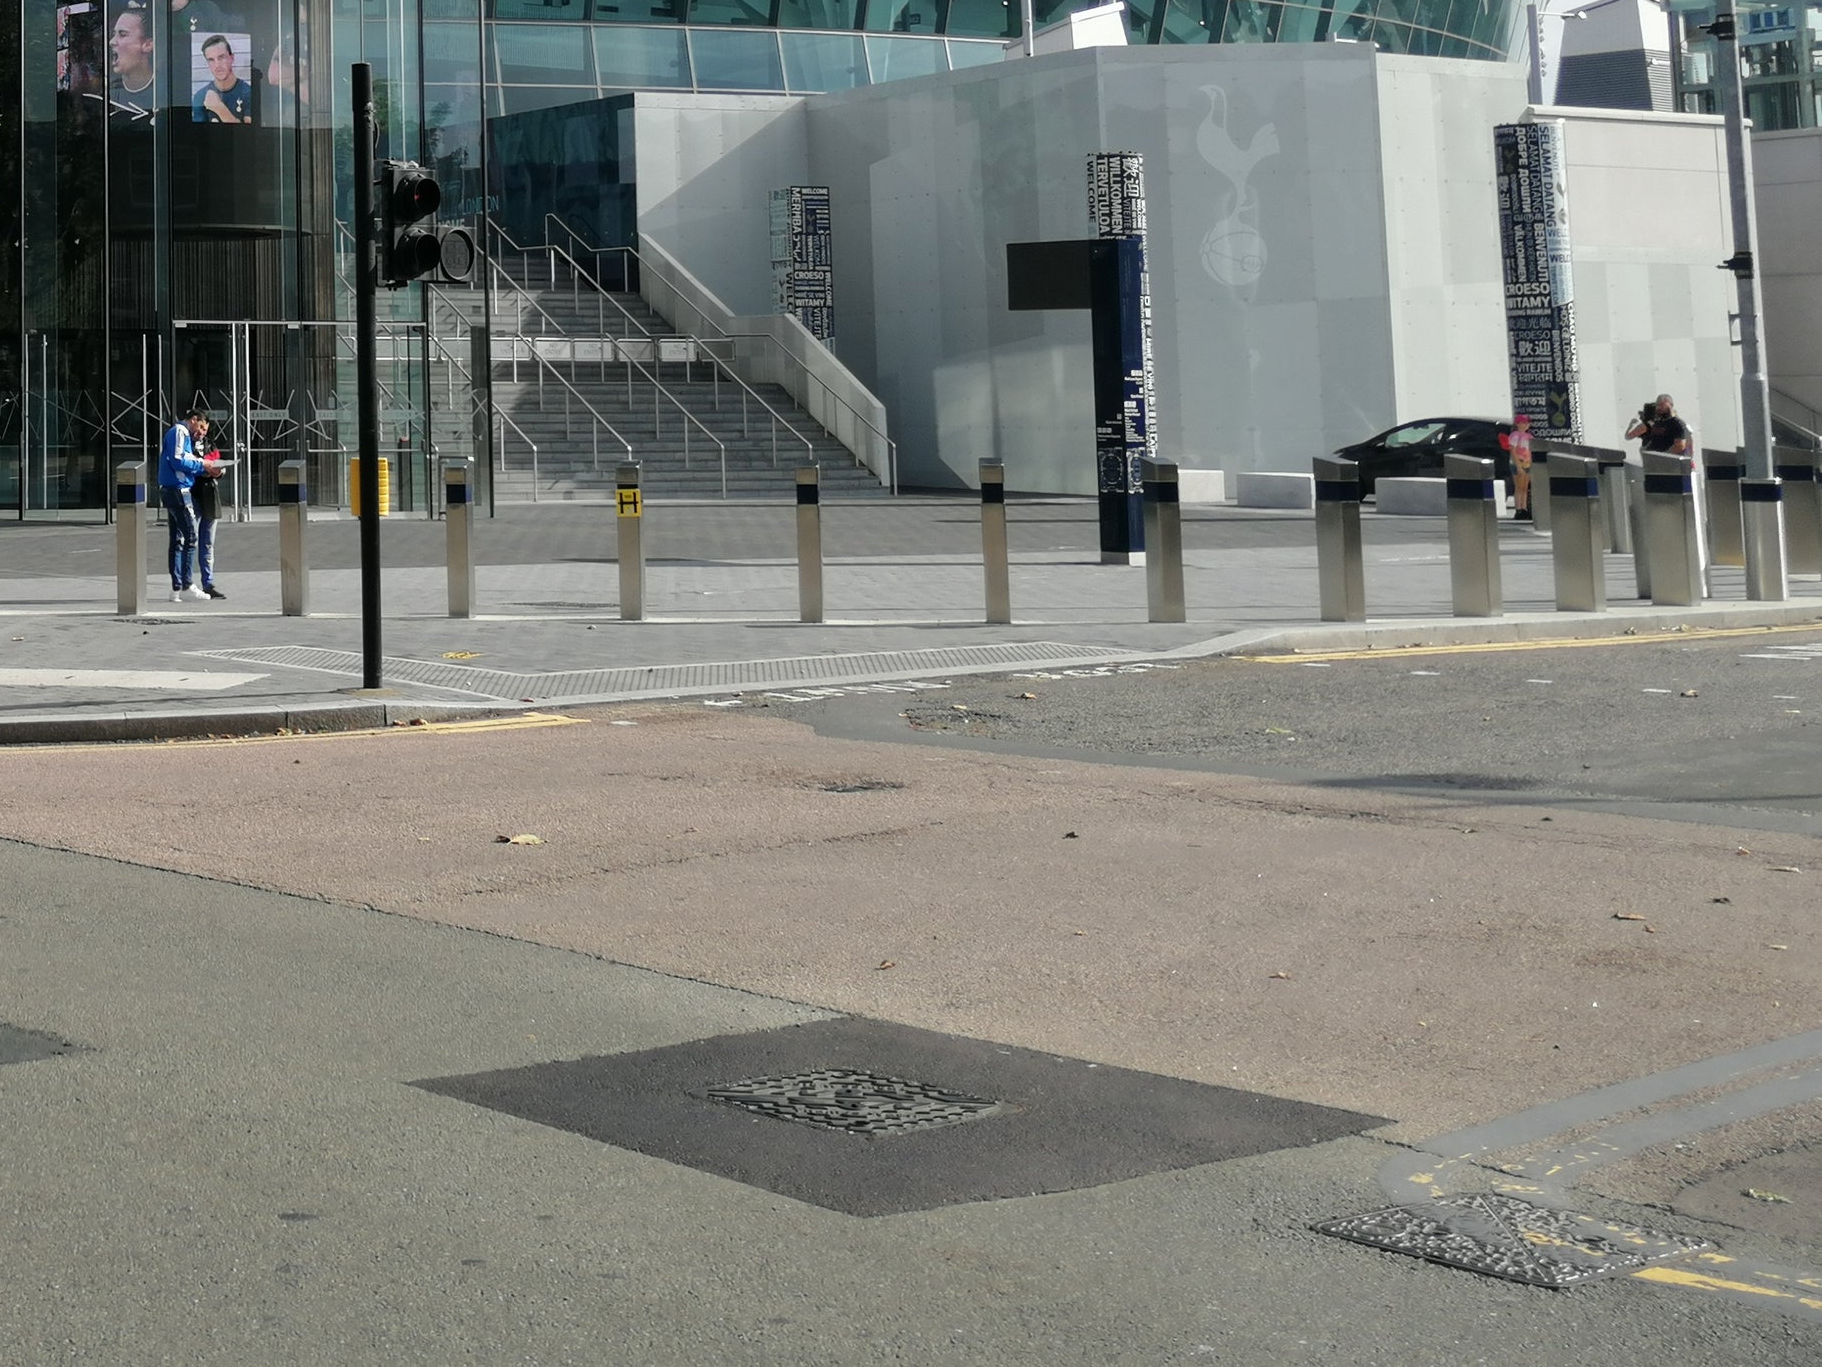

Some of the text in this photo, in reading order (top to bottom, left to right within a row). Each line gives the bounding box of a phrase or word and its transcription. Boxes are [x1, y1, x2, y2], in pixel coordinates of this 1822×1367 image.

[1086, 160, 1097, 223] WELCOME
[1097, 157, 1110, 234] TERVETULOA
[1109, 156, 1123, 234] WILLKOMMEN
[1527, 125, 1543, 213] SELAMAT DATANG
[1539, 126, 1557, 228] SELAMAT DATANG
[794, 271, 825, 280] CROESO
[1533, 222, 1548, 282] BENVENUTI
[1505, 282, 1550, 295] CROESO
